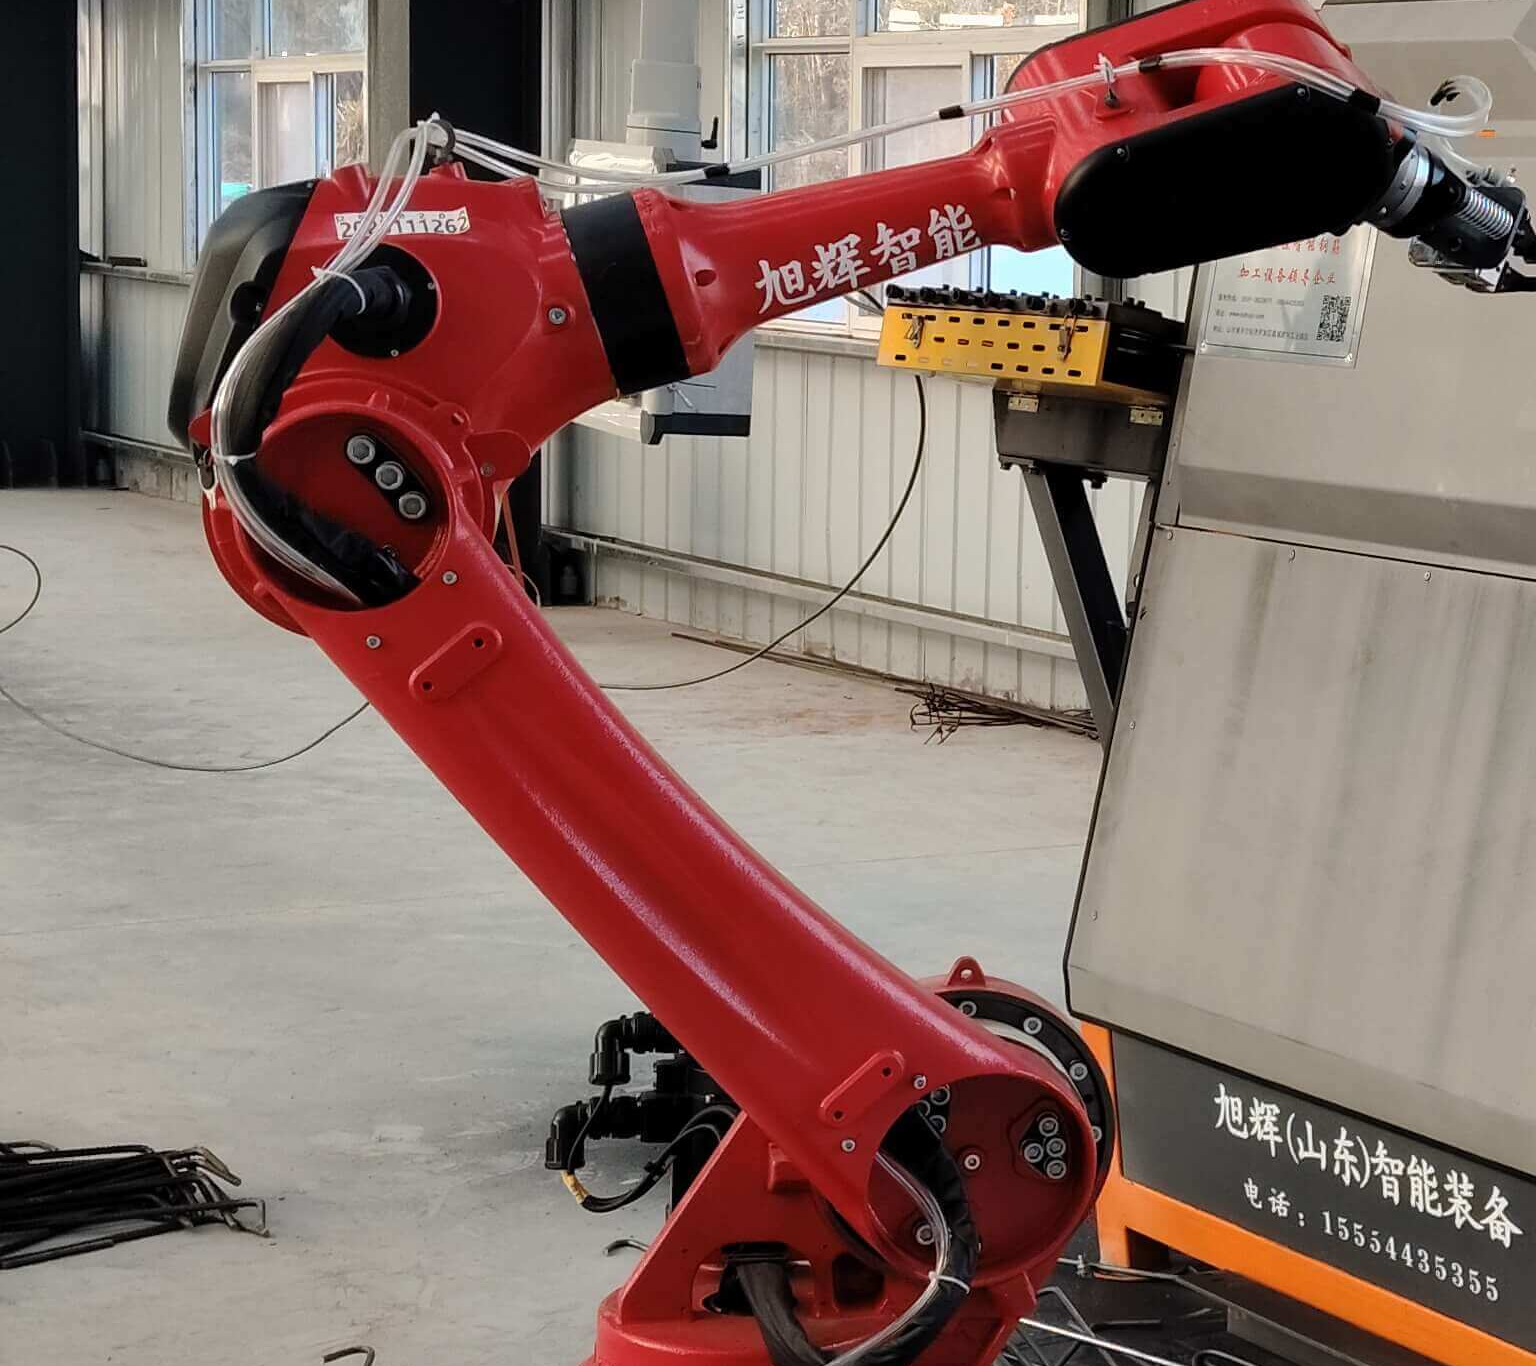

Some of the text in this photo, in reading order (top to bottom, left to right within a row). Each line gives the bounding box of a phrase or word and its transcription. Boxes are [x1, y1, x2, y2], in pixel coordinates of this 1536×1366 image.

[754, 203, 982, 314] 旭辉智能
[1322, 1210, 1499, 1303] 15554435355
